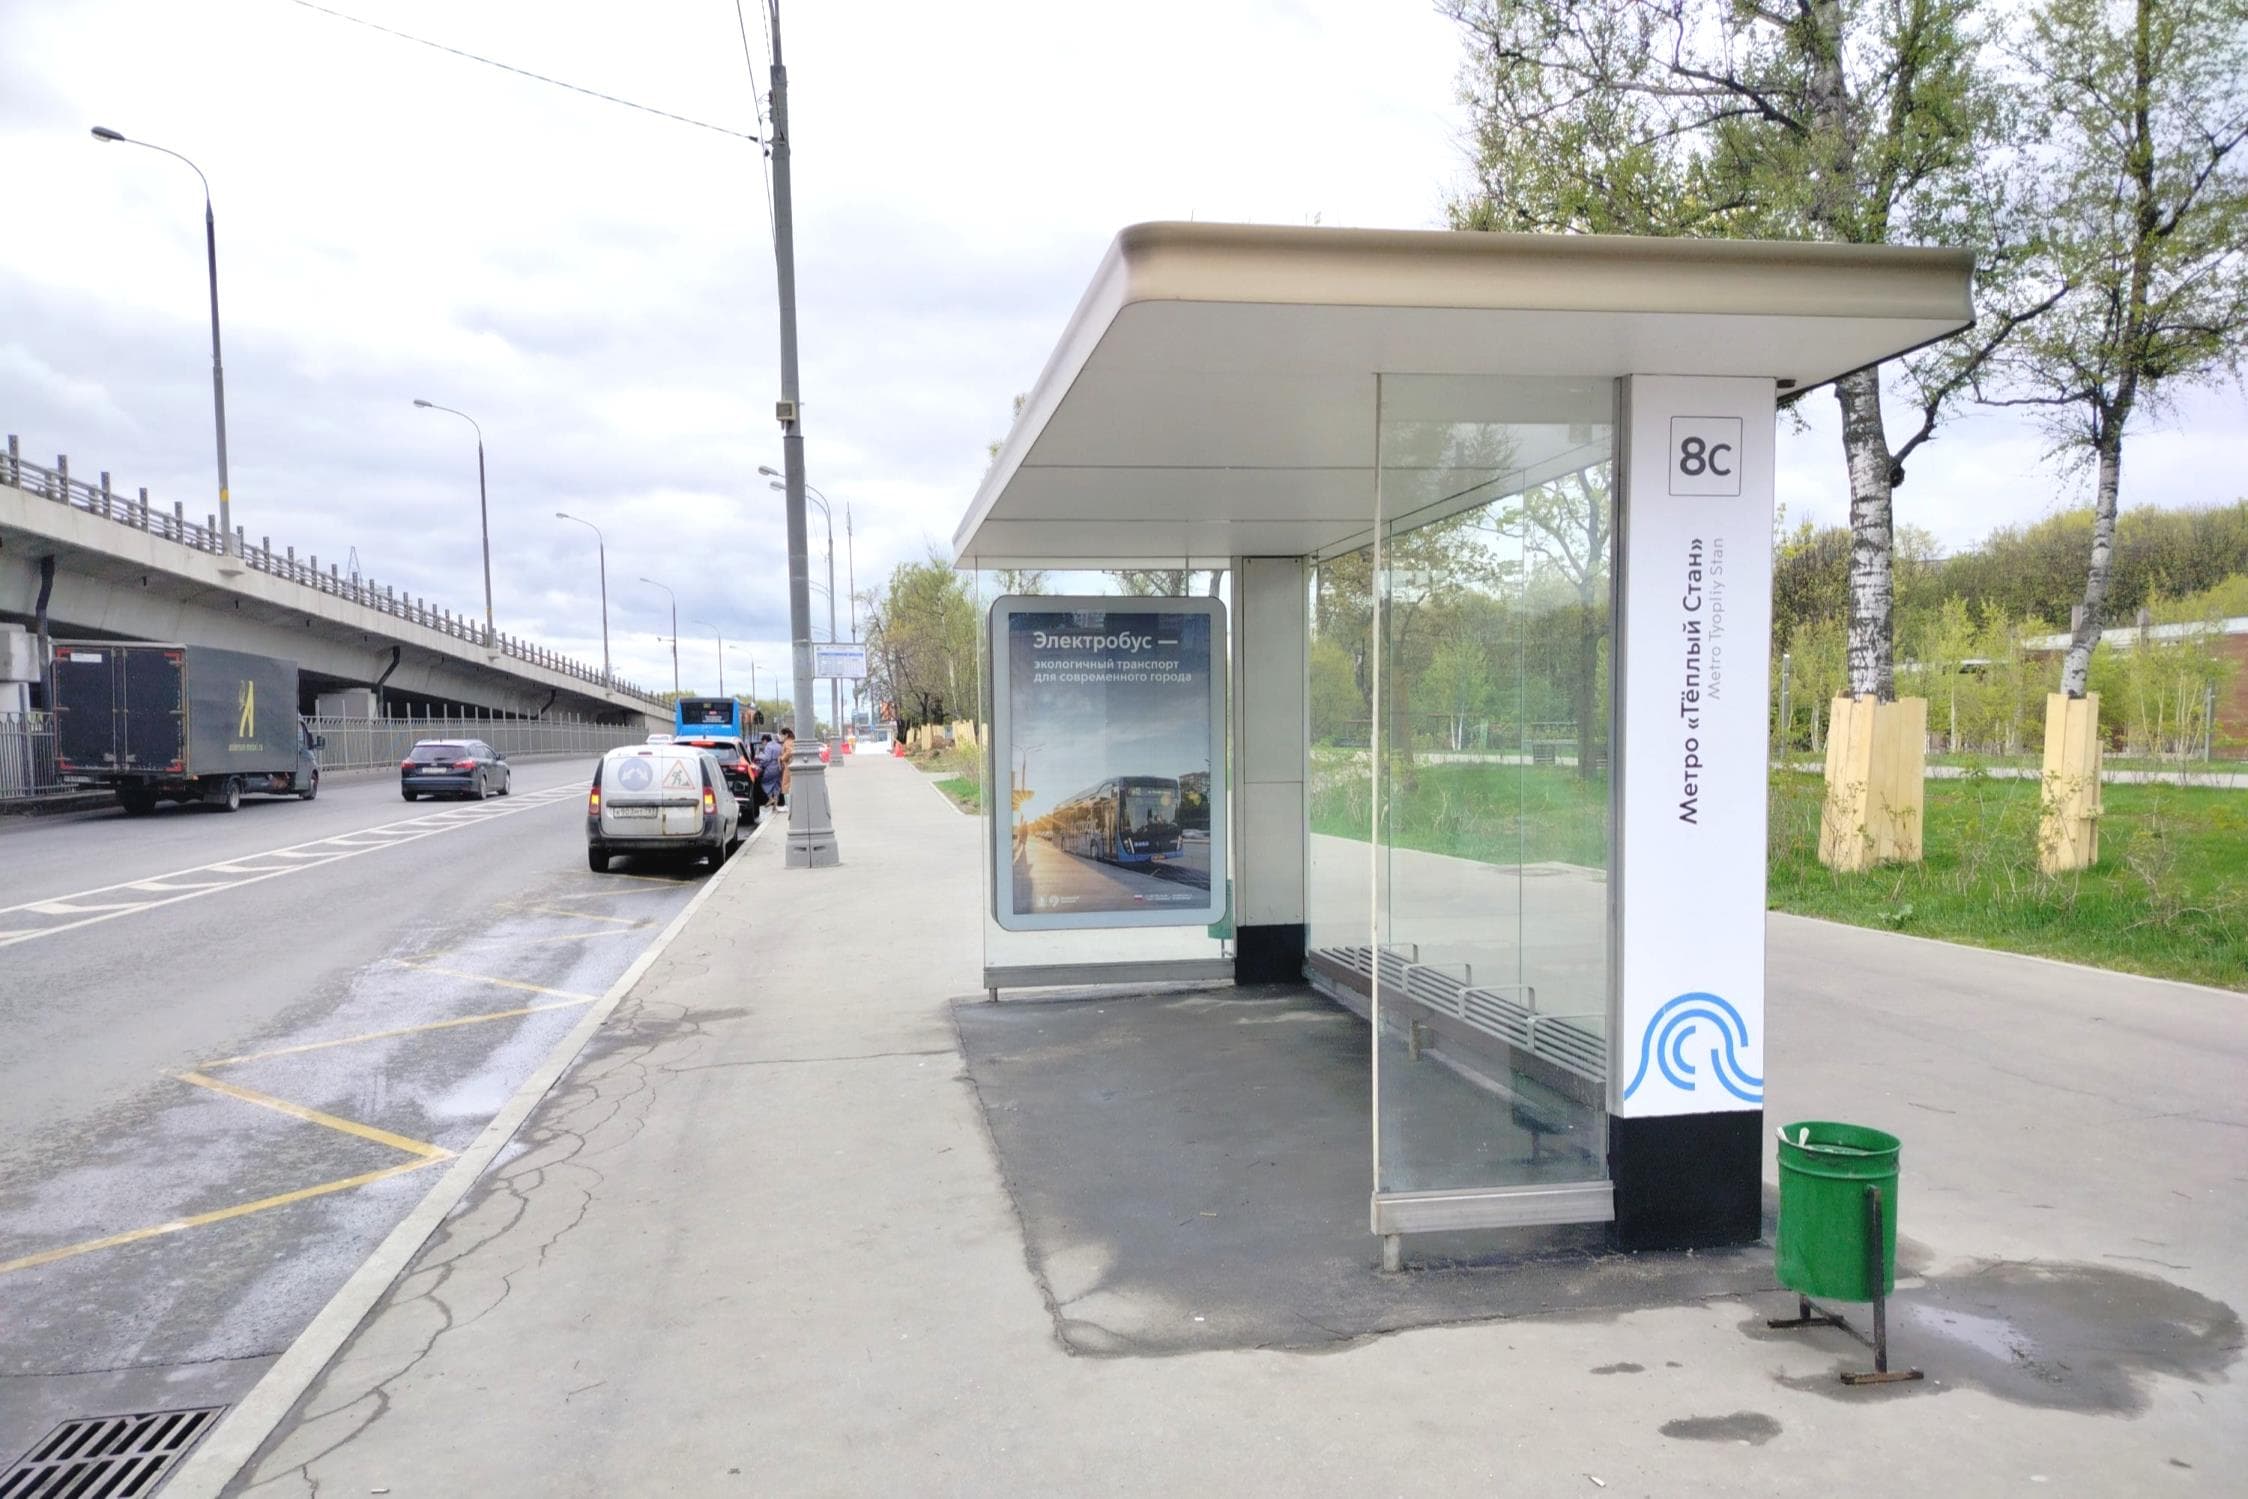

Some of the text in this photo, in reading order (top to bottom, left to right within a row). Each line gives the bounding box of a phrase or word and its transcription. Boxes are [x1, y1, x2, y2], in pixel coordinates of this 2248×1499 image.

[1707, 537, 1726, 701] Metro Tyopliy Stan
[1032, 631, 1153, 653] Электробус
[1033, 658, 1180, 672] экологичный транспорт
[1032, 672, 1192, 685] для современного города
[1678, 538, 1703, 825] Метро «Тёплый Стан»
